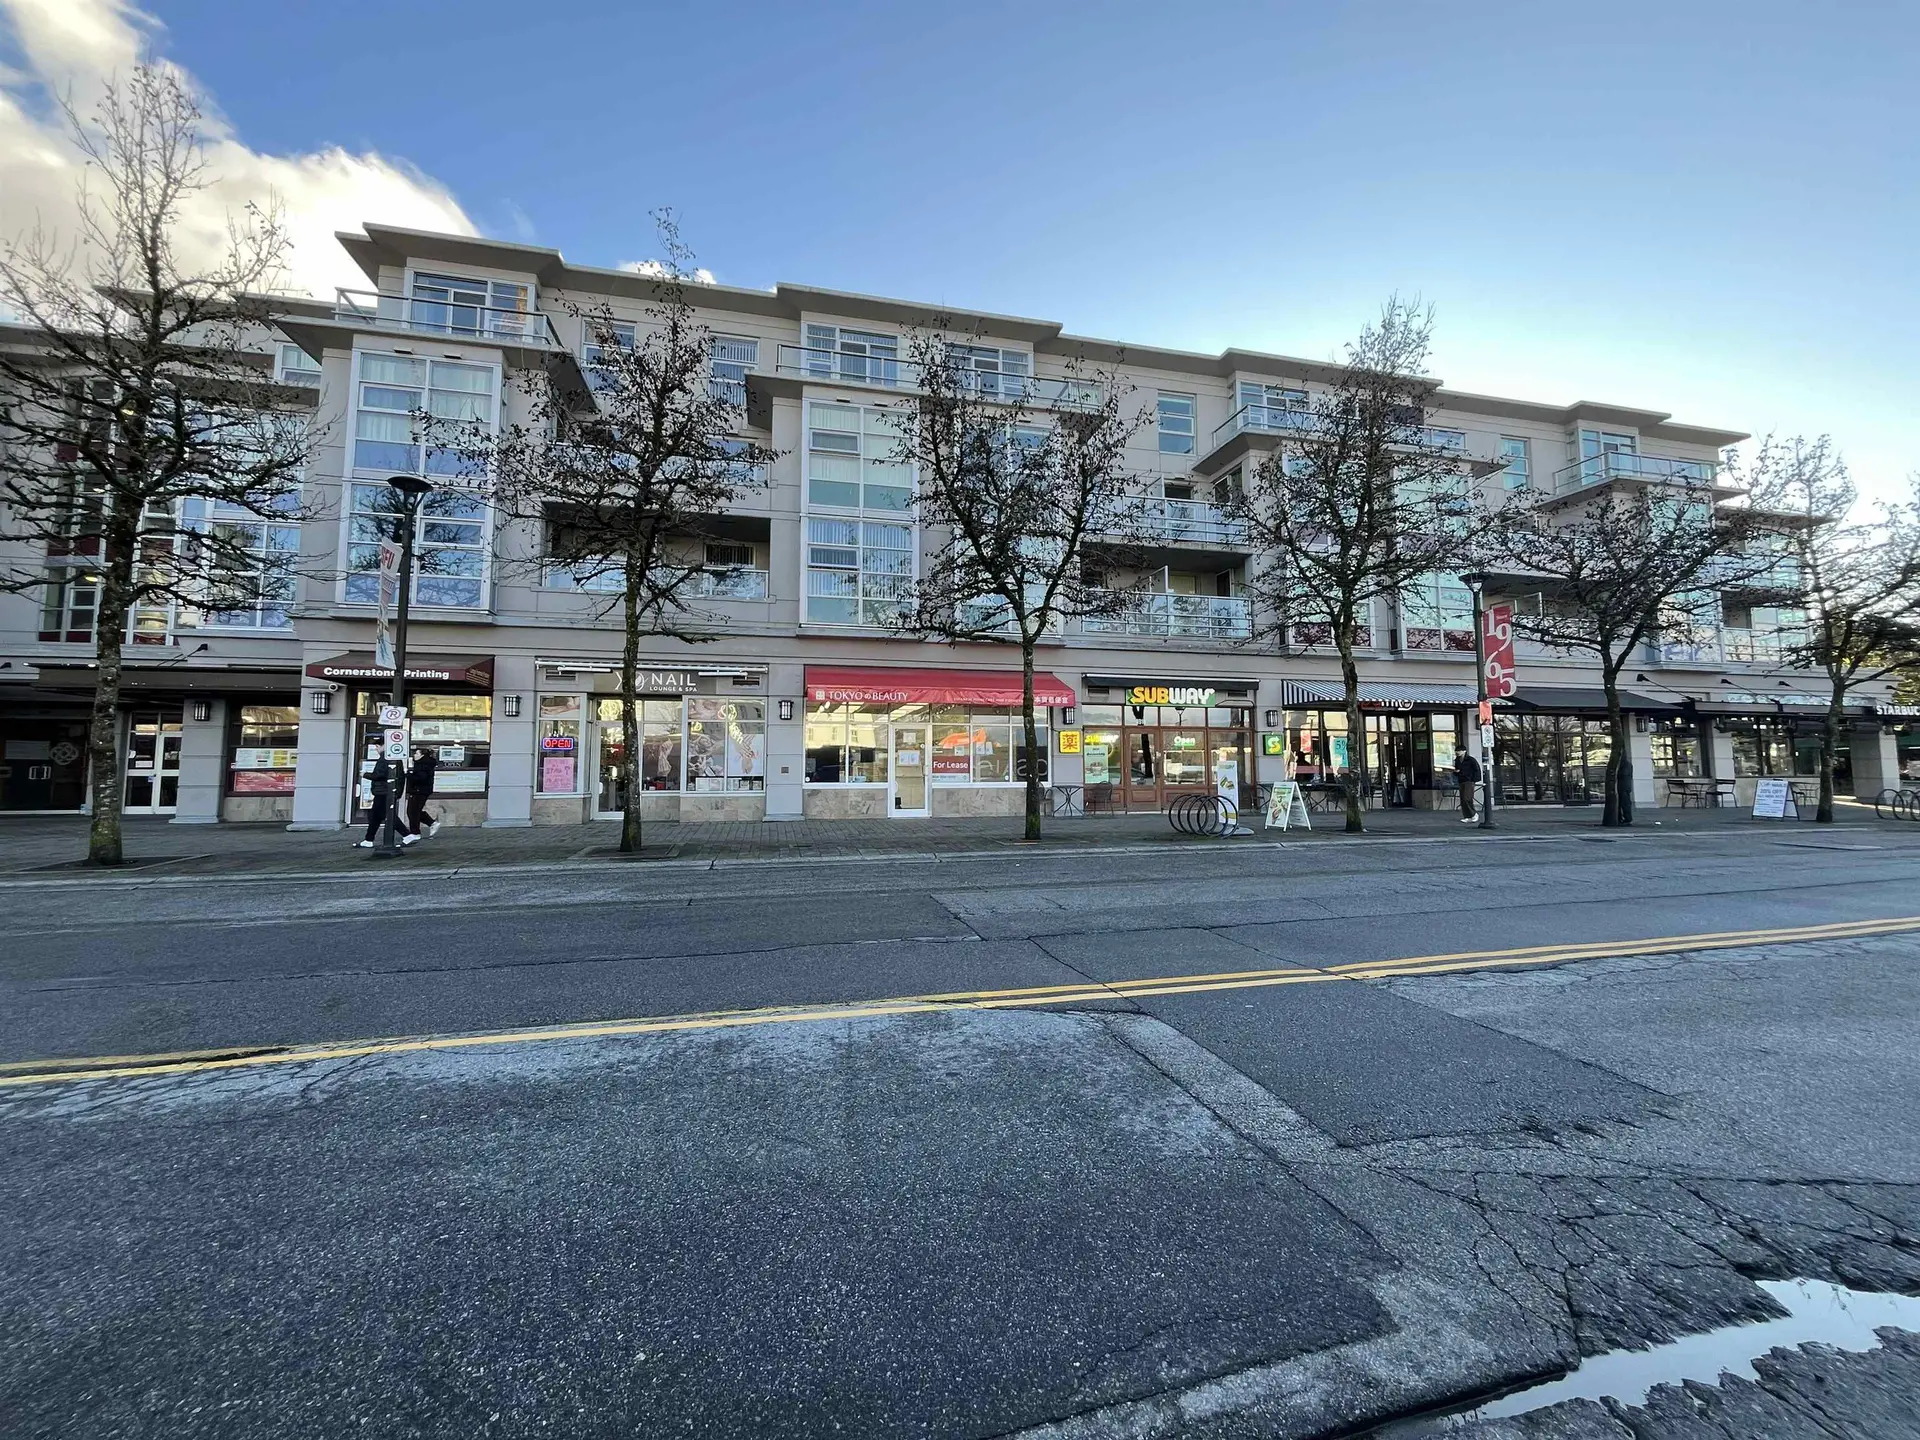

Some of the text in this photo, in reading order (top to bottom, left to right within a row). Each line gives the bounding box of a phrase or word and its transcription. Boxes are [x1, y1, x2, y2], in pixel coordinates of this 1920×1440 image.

[403, 669, 450, 680] Printing
[651, 673, 697, 686] NAIL
[828, 691, 863, 701] TOKYO
[872, 691, 909, 701] BEAUTY
[1128, 686, 1215, 705] SUBWAY
[544, 739, 571, 748] OPEN
[1173, 736, 1196, 747] Open
[933, 761, 969, 769] For Lease
